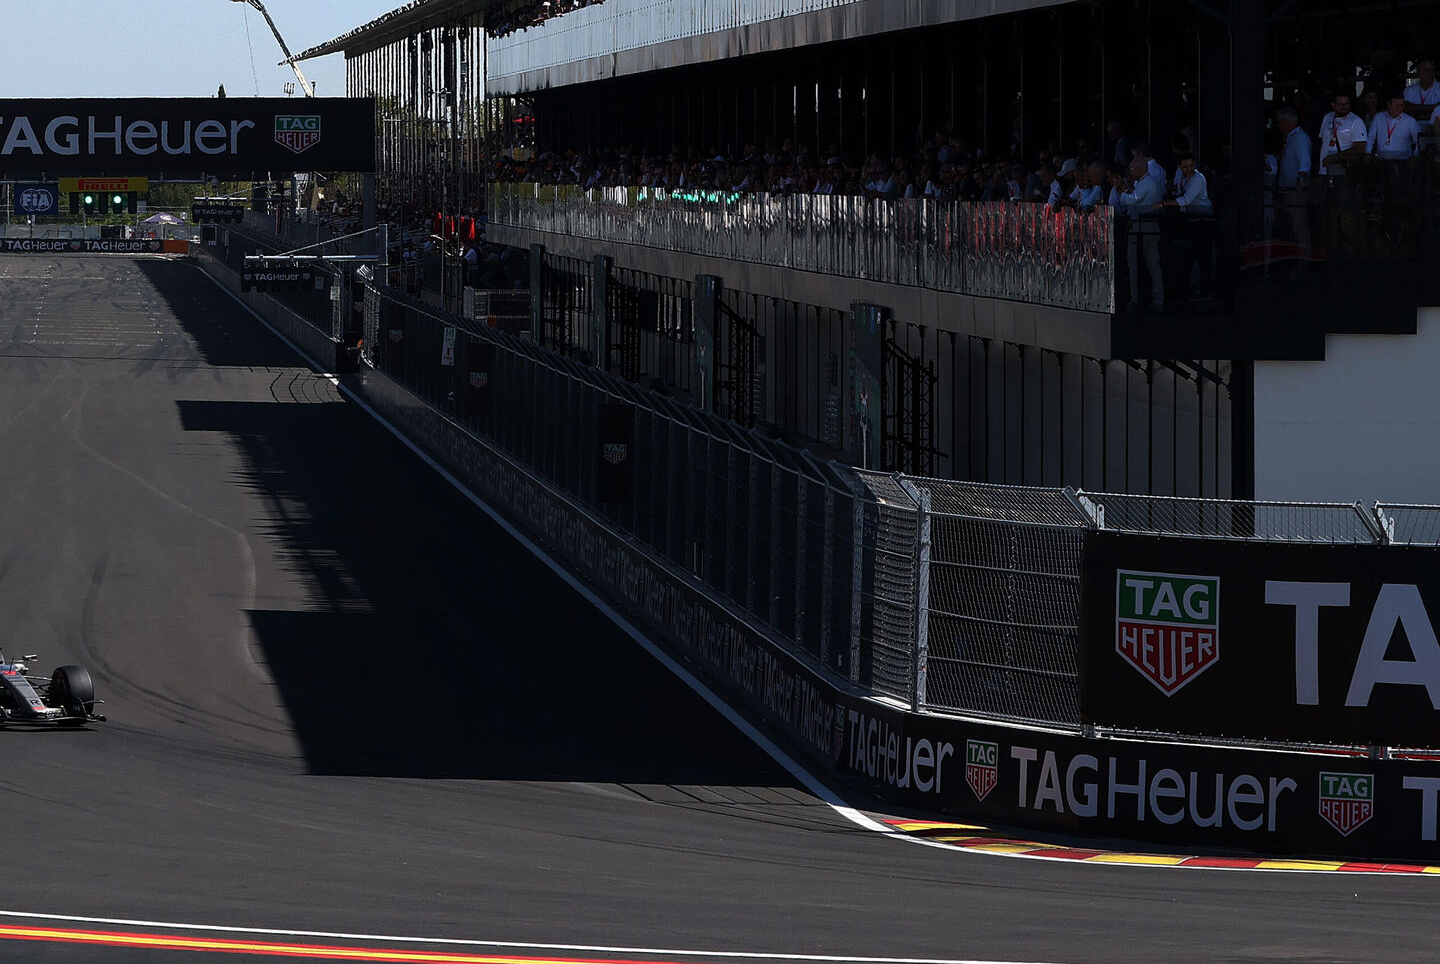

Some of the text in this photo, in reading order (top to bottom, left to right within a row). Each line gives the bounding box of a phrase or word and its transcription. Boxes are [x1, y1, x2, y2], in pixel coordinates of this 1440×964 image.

[278, 117, 318, 131] TAG
[276, 132, 319, 151] HEUER
[1125, 579, 1210, 620] TAG
[1122, 626, 1213, 686] HEUER
[968, 743, 997, 765] TAG
[967, 767, 997, 796] HEUER
[1323, 776, 1368, 798] TAG
[1321, 801, 1370, 833] HEUER
